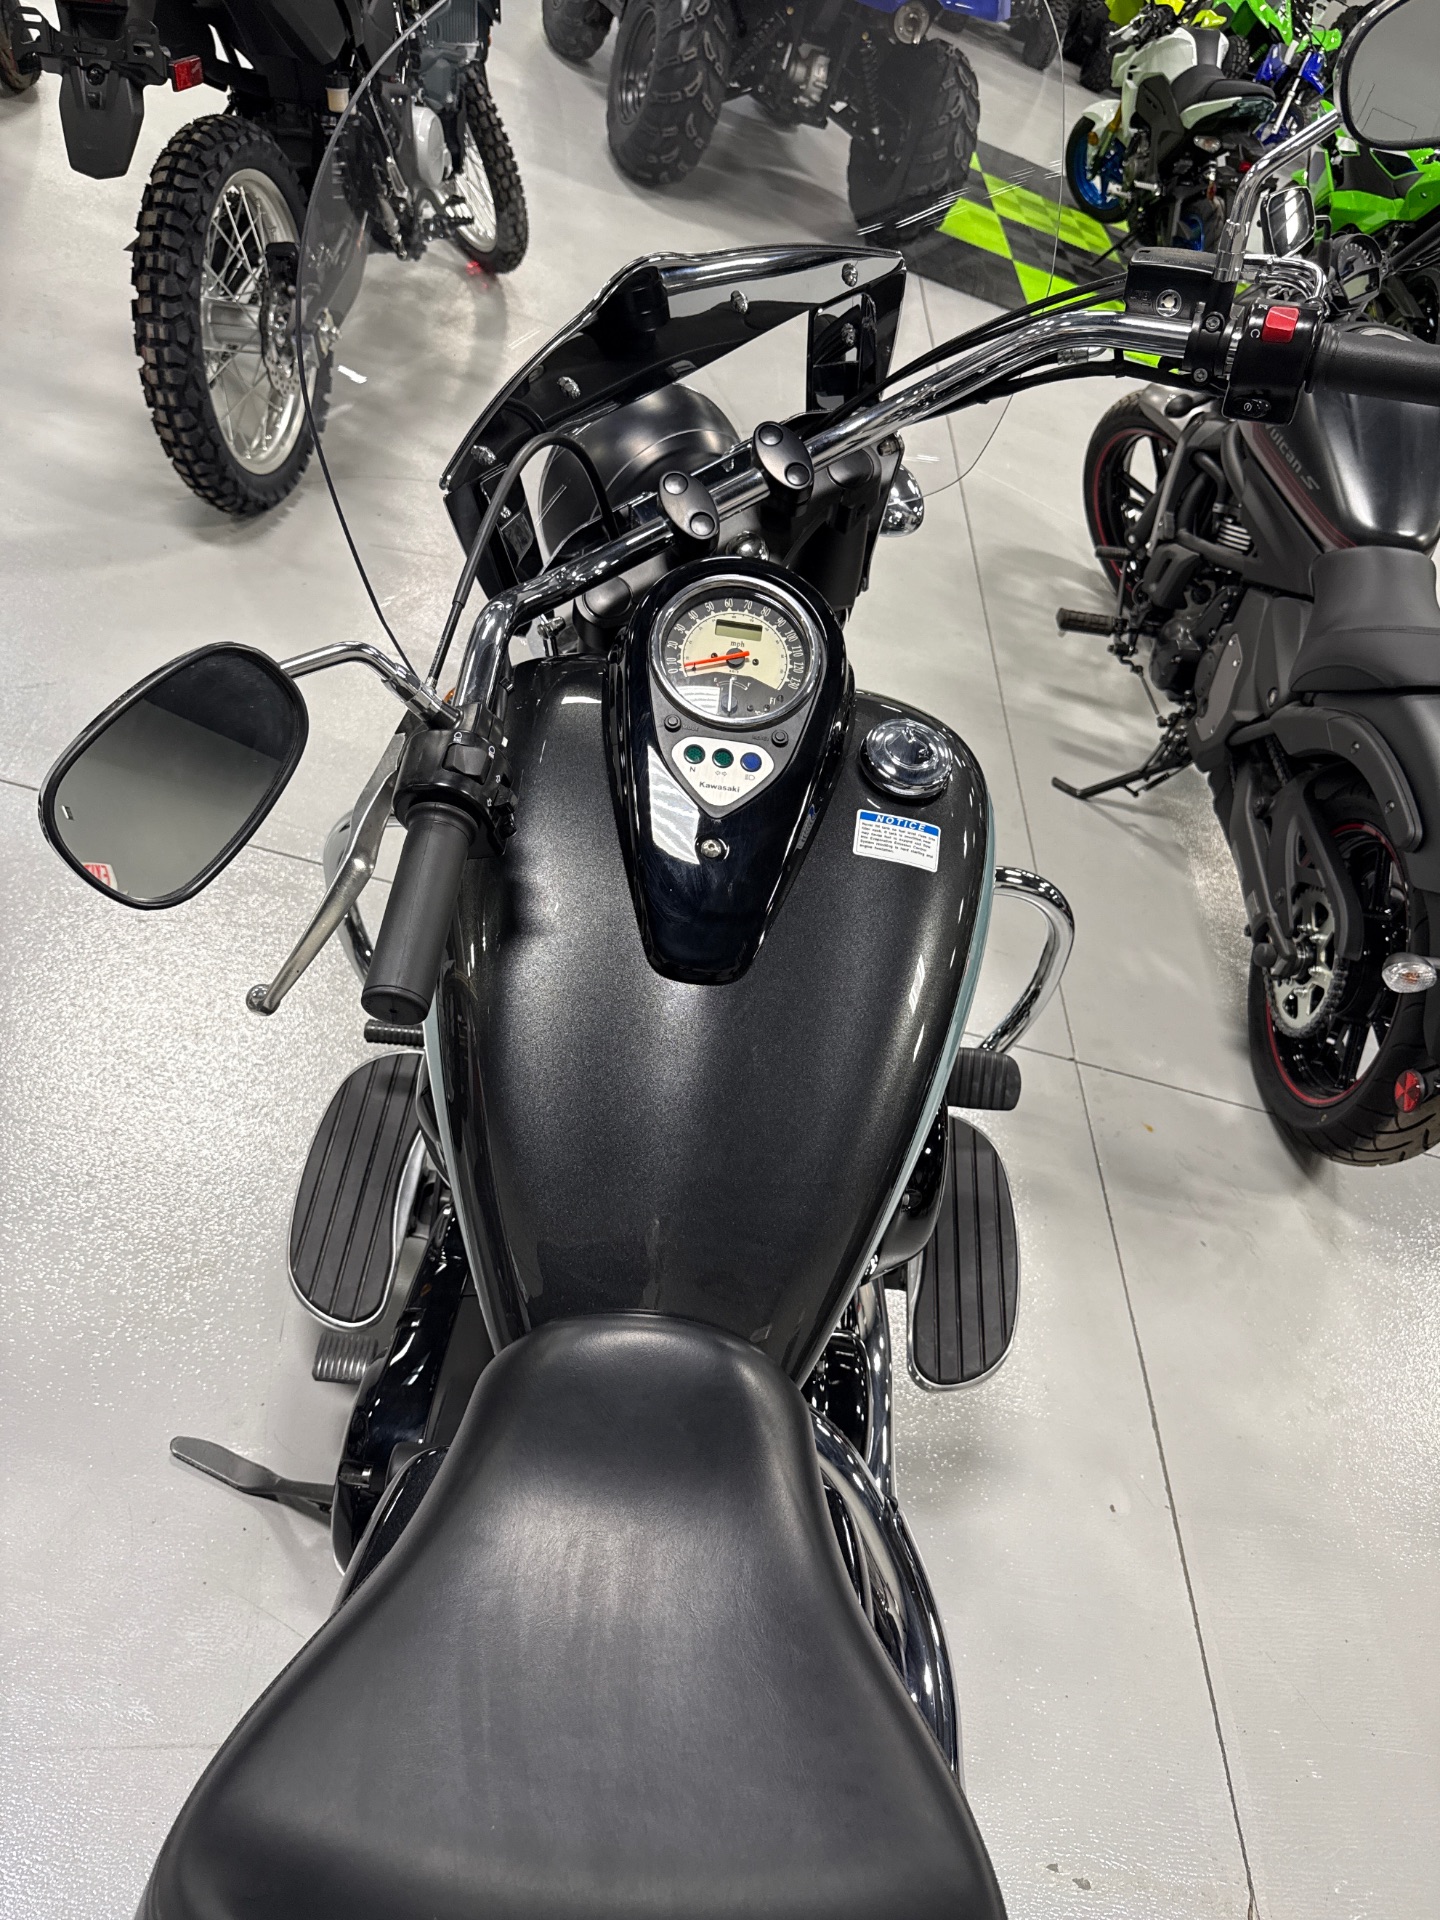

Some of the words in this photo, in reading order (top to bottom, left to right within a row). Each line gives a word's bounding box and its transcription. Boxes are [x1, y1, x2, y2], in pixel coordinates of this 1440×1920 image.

[1300, 475, 1320, 490] S
[704, 600, 714, 612] 50
[725, 598, 734, 608] 60
[744, 600, 752, 610] 70
[688, 610, 698, 620] 40
[761, 606, 772, 617] 80
[776, 616, 786, 628] 90
[674, 623, 686, 634] 30
[785, 630, 798, 642] 100
[667, 640, 678, 650] 20
[792, 645, 804, 658] 110
[666, 658, 678, 666] 10
[793, 662, 804, 674] 120
[788, 676, 800, 690] 130
[699, 781, 740, 793] Kawasaki
[876, 815, 926, 831] NOTICE
